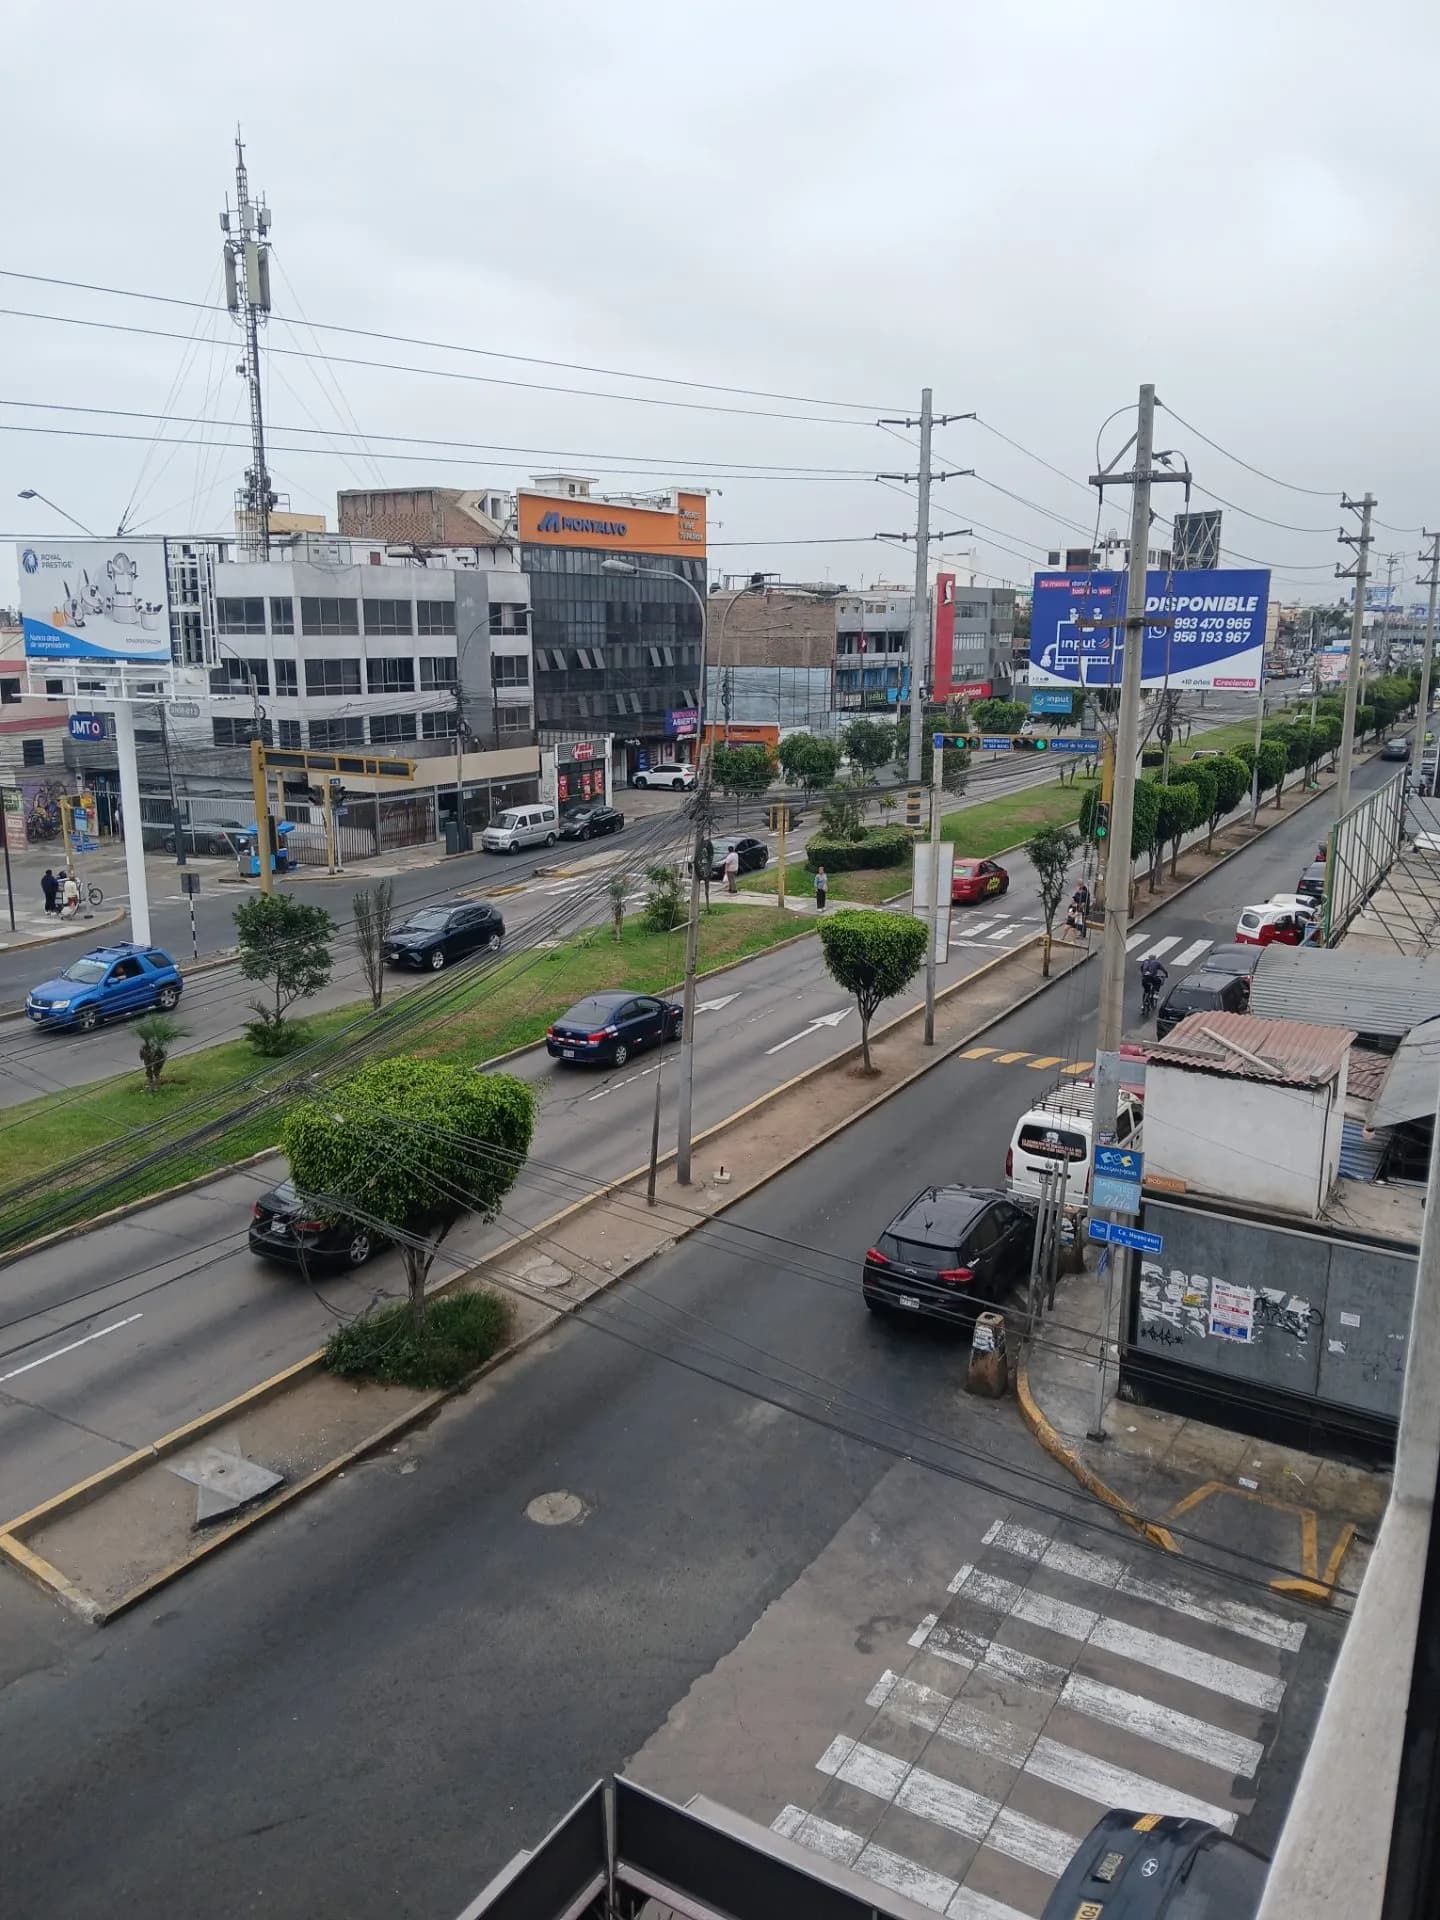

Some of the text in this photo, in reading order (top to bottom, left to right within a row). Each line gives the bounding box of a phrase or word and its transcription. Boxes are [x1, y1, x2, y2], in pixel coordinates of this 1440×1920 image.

[562, 517, 627, 536] MONTALVO
[1145, 596, 1259, 612] DISPONIBLE
[1174, 617, 1252, 629] 993 470 965
[1173, 631, 1251, 643] 956 193 967
[1061, 638, 1096, 651] input
